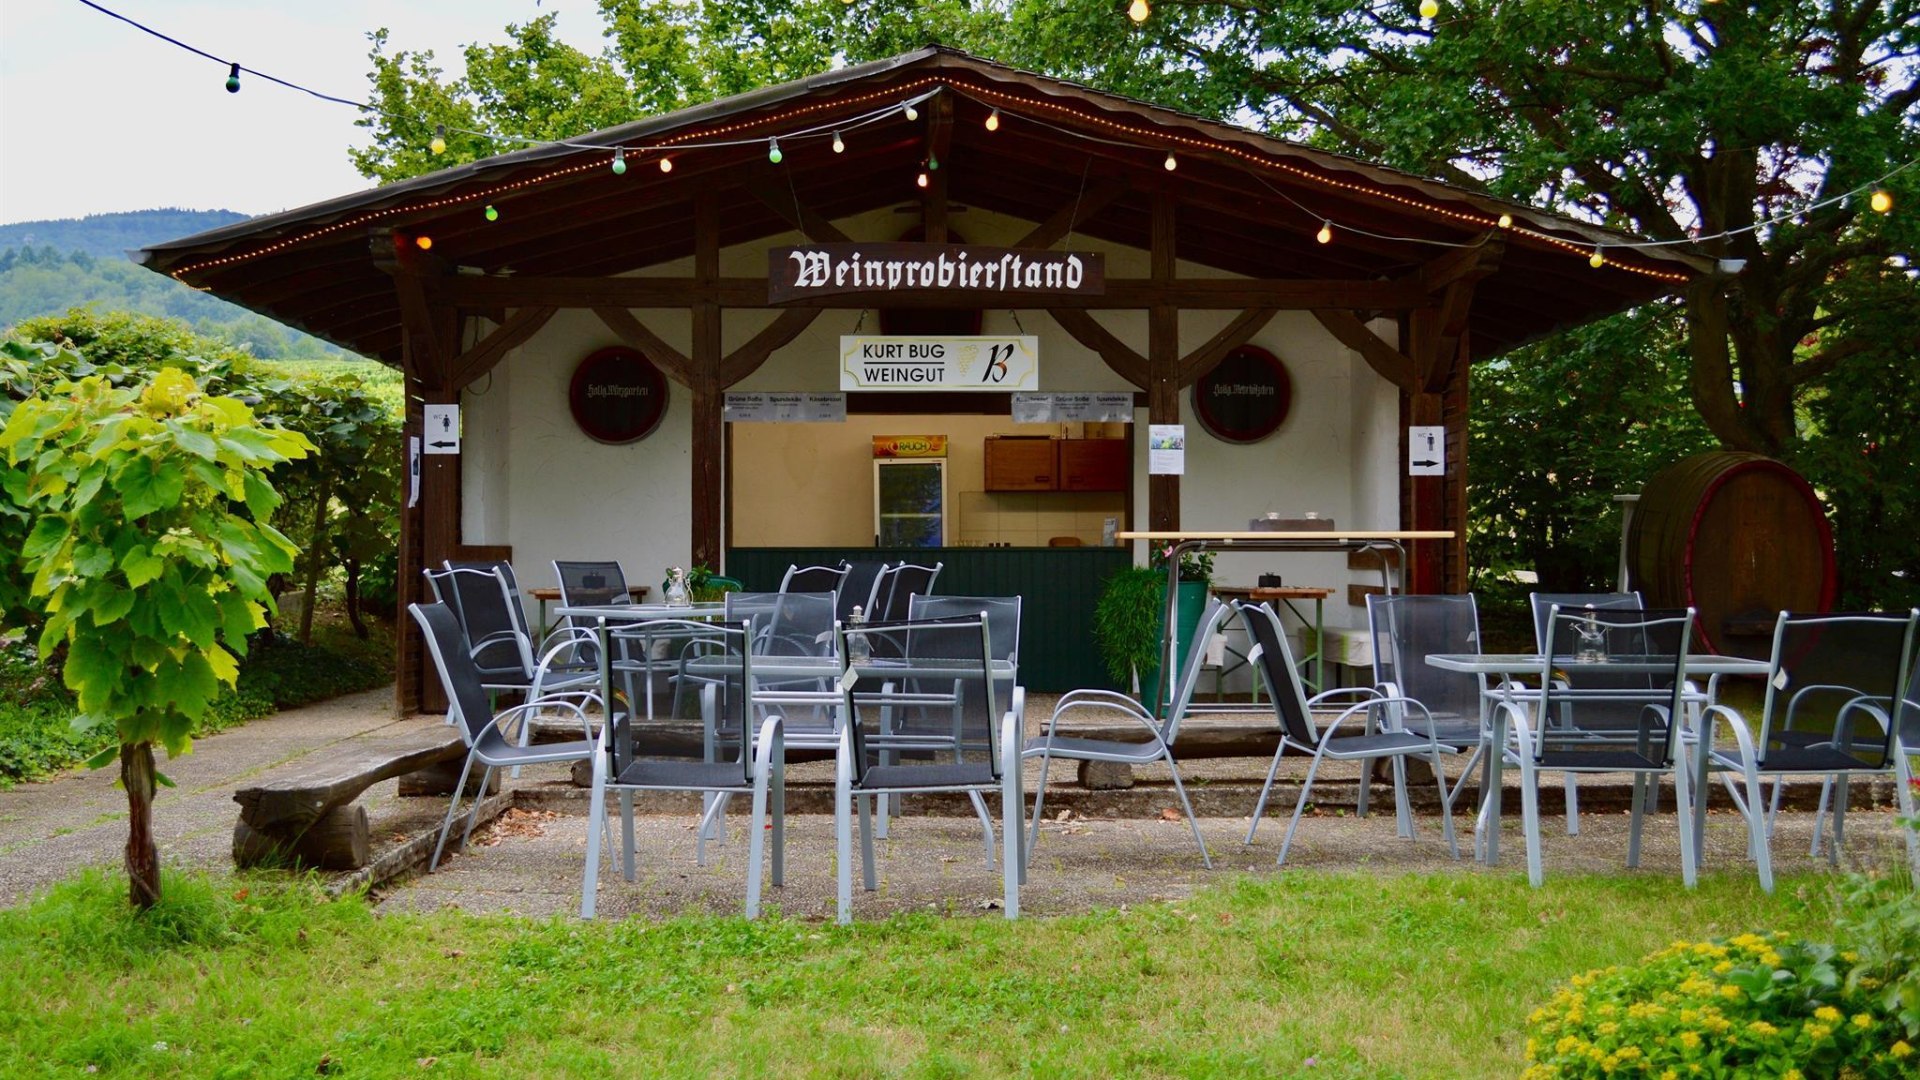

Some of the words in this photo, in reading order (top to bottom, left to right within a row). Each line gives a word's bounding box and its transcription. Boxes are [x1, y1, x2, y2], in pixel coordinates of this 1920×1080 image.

[863, 344, 904, 358] KURT
[909, 344, 945, 358] BUG
[864, 368, 945, 382] WEINGUT
[899, 441, 927, 451] RAUCH
